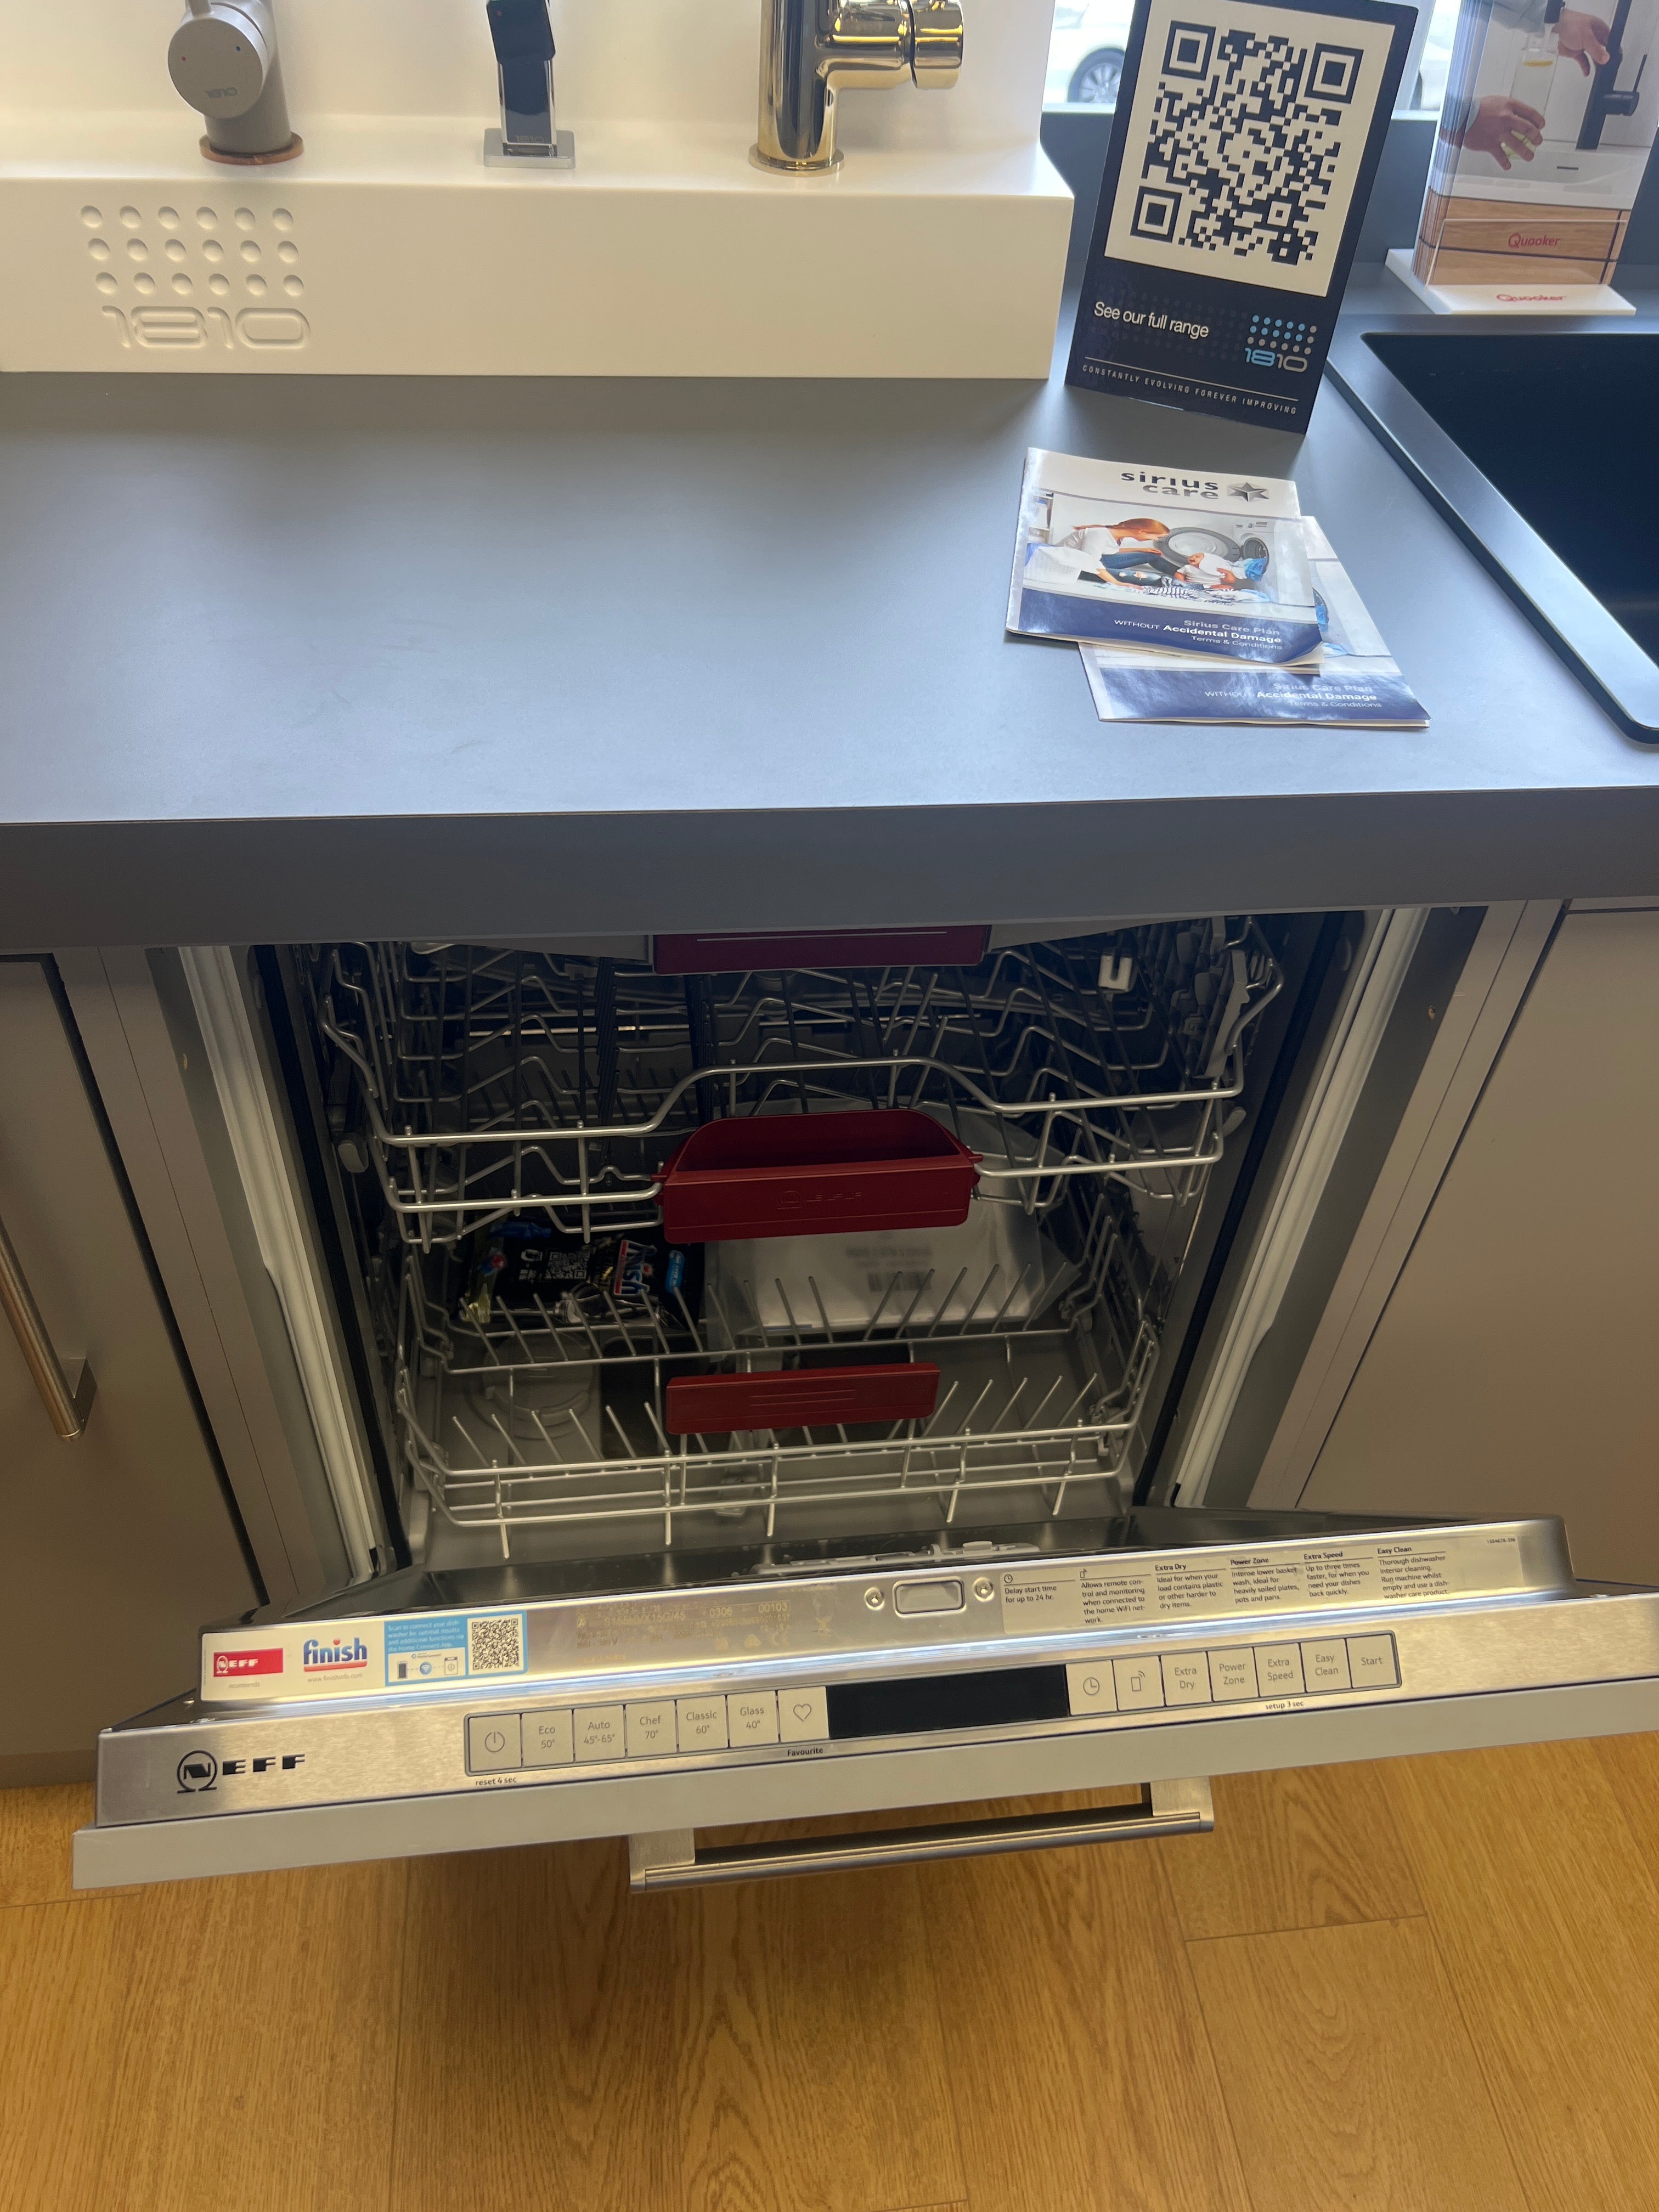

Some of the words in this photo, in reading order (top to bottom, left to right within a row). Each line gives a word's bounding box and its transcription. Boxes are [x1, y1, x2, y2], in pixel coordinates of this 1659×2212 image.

[1508, 232, 1561, 249] Quooker
[1094, 301, 1120, 320] See
[1122, 310, 1146, 325] our
[1148, 312, 1168, 330] full
[1169, 320, 1209, 339] range
[102, 306, 311, 349] 1810
[1245, 347, 1308, 373] 1810
[1082, 364, 1140, 383] CONSTANTLY
[1144, 377, 1190, 393] EVOLVING
[1195, 388, 1237, 403] FOREVER
[1242, 398, 1296, 415] IMPROVING
[1121, 471, 1218, 490] sirius
[1143, 484, 1218, 499] care
[1114, 619, 1160, 630] WITHOUT
[1163, 625, 1227, 637] Accidental
[1232, 633, 1281, 643] Damage
[1184, 620, 1218, 629] Sirius
[1253, 627, 1280, 635] Plan
[1191, 635, 1221, 644] Terms
[1232, 640, 1282, 650] Conditions
[1379, 1558, 1409, 1566] Thorough
[1005, 1586, 1023, 1594] Delay
[1173, 1582, 1201, 1590] contains
[1203, 1581, 1223, 1589] plastic
[1109, 1587, 1145, 1595] monitoring
[709, 1606, 732, 1617] 0306
[758, 1601, 787, 1613] 00103
[303, 1637, 368, 1666] finish
[1267, 1658, 1290, 1668] Extra
[1315, 1654, 1335, 1664] Easy
[1361, 1656, 1383, 1666] Start
[1174, 1666, 1197, 1676] Extra
[1219, 1662, 1246, 1673] Power
[1315, 1666, 1339, 1677] Clean
[307, 1673, 363, 1683] www.finishinfo.com
[1223, 1675, 1245, 1685] Zone
[1267, 1670, 1294, 1682] Speed
[229, 1681, 261, 1689] recommends
[1180, 1680, 1195, 1690] Dry
[740, 1706, 764, 1716] Glass
[1265, 1702, 1285, 1710] setup
[640, 1715, 662, 1725] Chef
[686, 1711, 718, 1722] Classic
[588, 1721, 611, 1730] Auto
[696, 1725, 710, 1734] 60°
[746, 1720, 760, 1729] 40°
[539, 1725, 555, 1735] Eco
[645, 1729, 659, 1739] 70°
[541, 1739, 556, 1748] 50°
[584, 1733, 616, 1745] 45°-65°
[787, 1747, 823, 1756] Favourite
[177, 1750, 305, 1794] NEFF
[475, 1778, 496, 1786] reset
